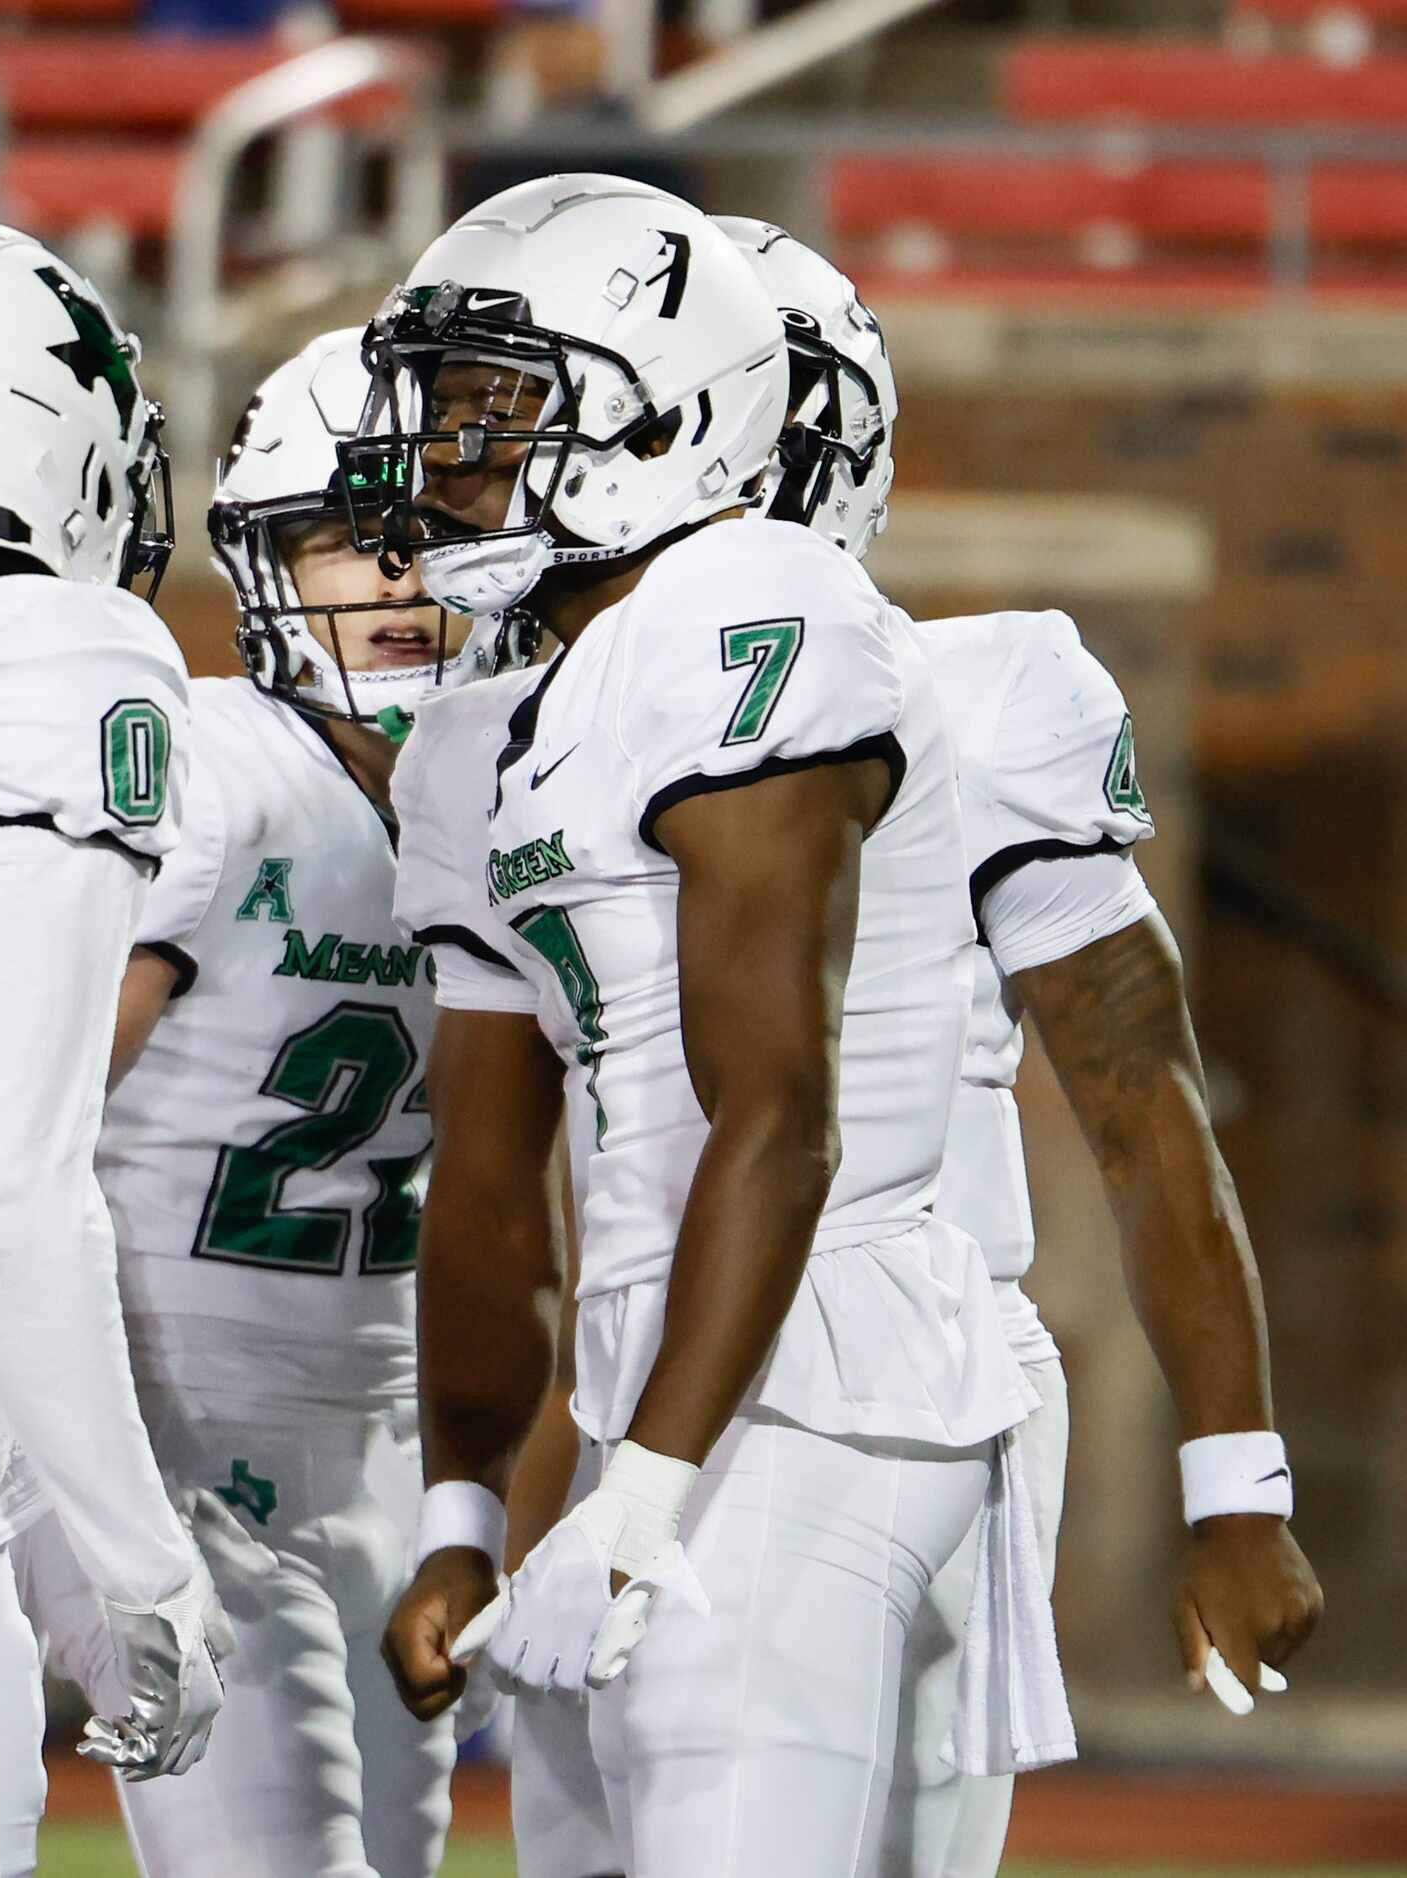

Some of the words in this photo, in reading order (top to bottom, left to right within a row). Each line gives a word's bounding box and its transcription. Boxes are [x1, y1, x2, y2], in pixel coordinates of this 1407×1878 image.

[720, 617, 804, 747] 7
[101, 698, 171, 826] 0
[489, 828, 576, 899] GREEN
[272, 929, 424, 987] MEAN
